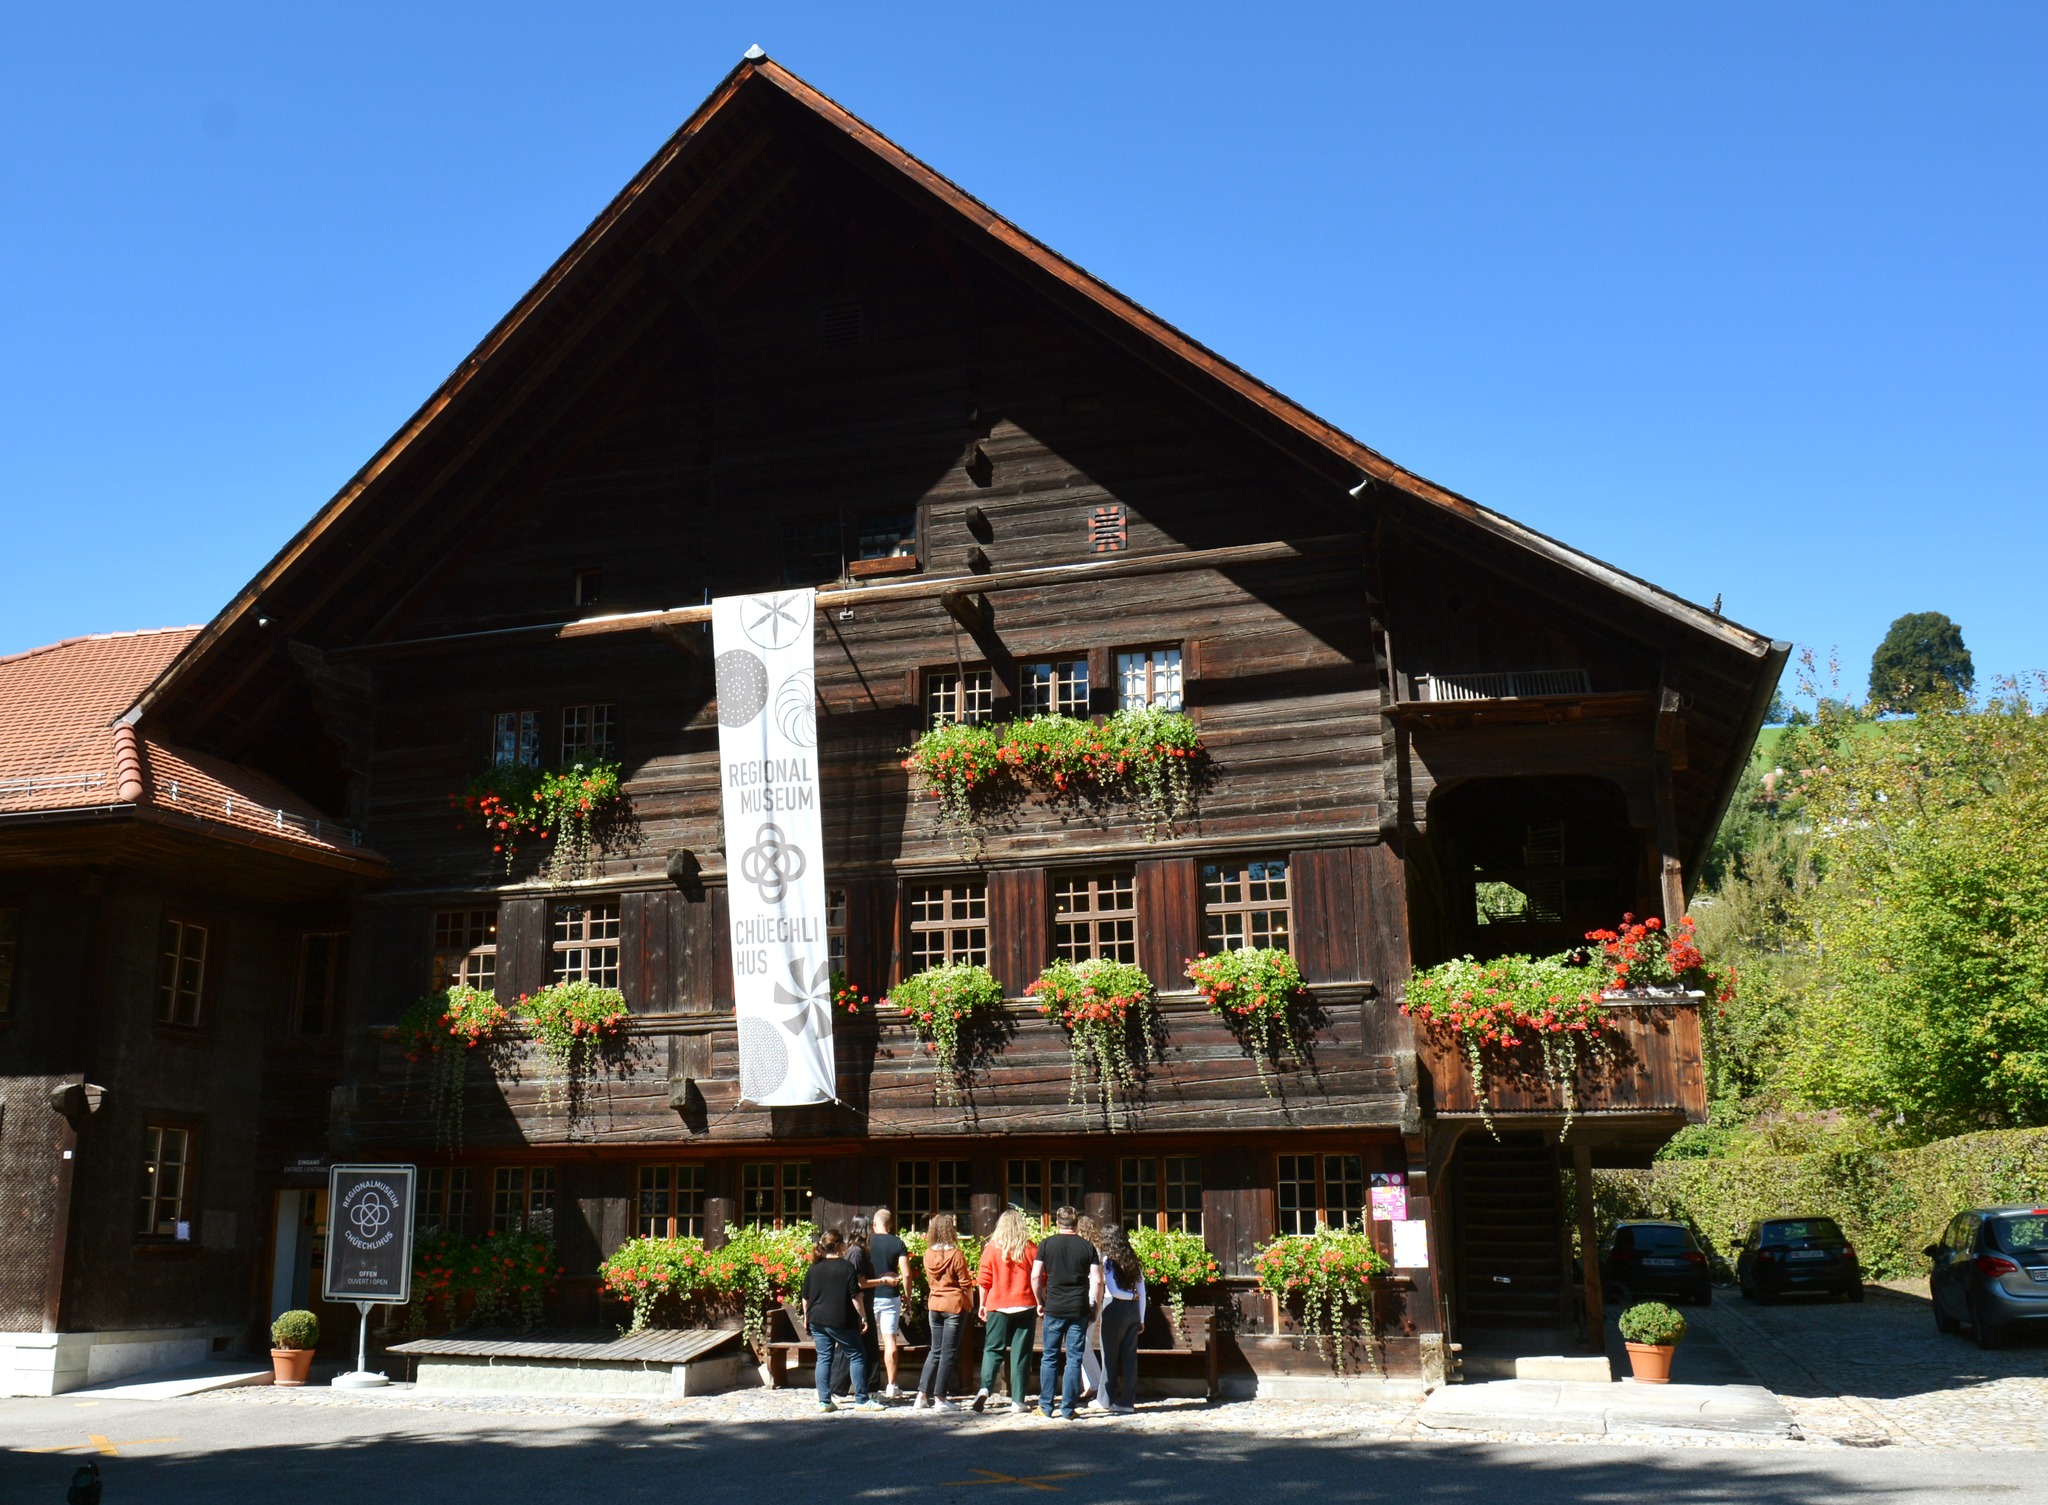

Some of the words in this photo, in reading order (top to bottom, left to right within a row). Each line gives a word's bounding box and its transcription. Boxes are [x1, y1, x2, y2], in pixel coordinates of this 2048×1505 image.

[729, 758, 812, 788] REGIONAL
[741, 786, 814, 814] MUSEUM
[735, 914, 819, 945] CHÜECHLI
[736, 949, 768, 976] HUS
[342, 1180, 399, 1209] REGIONALMUSEUM
[344, 1230, 394, 1250] CHÜECHLIHUS
[372, 1278, 388, 1286] OPEN
